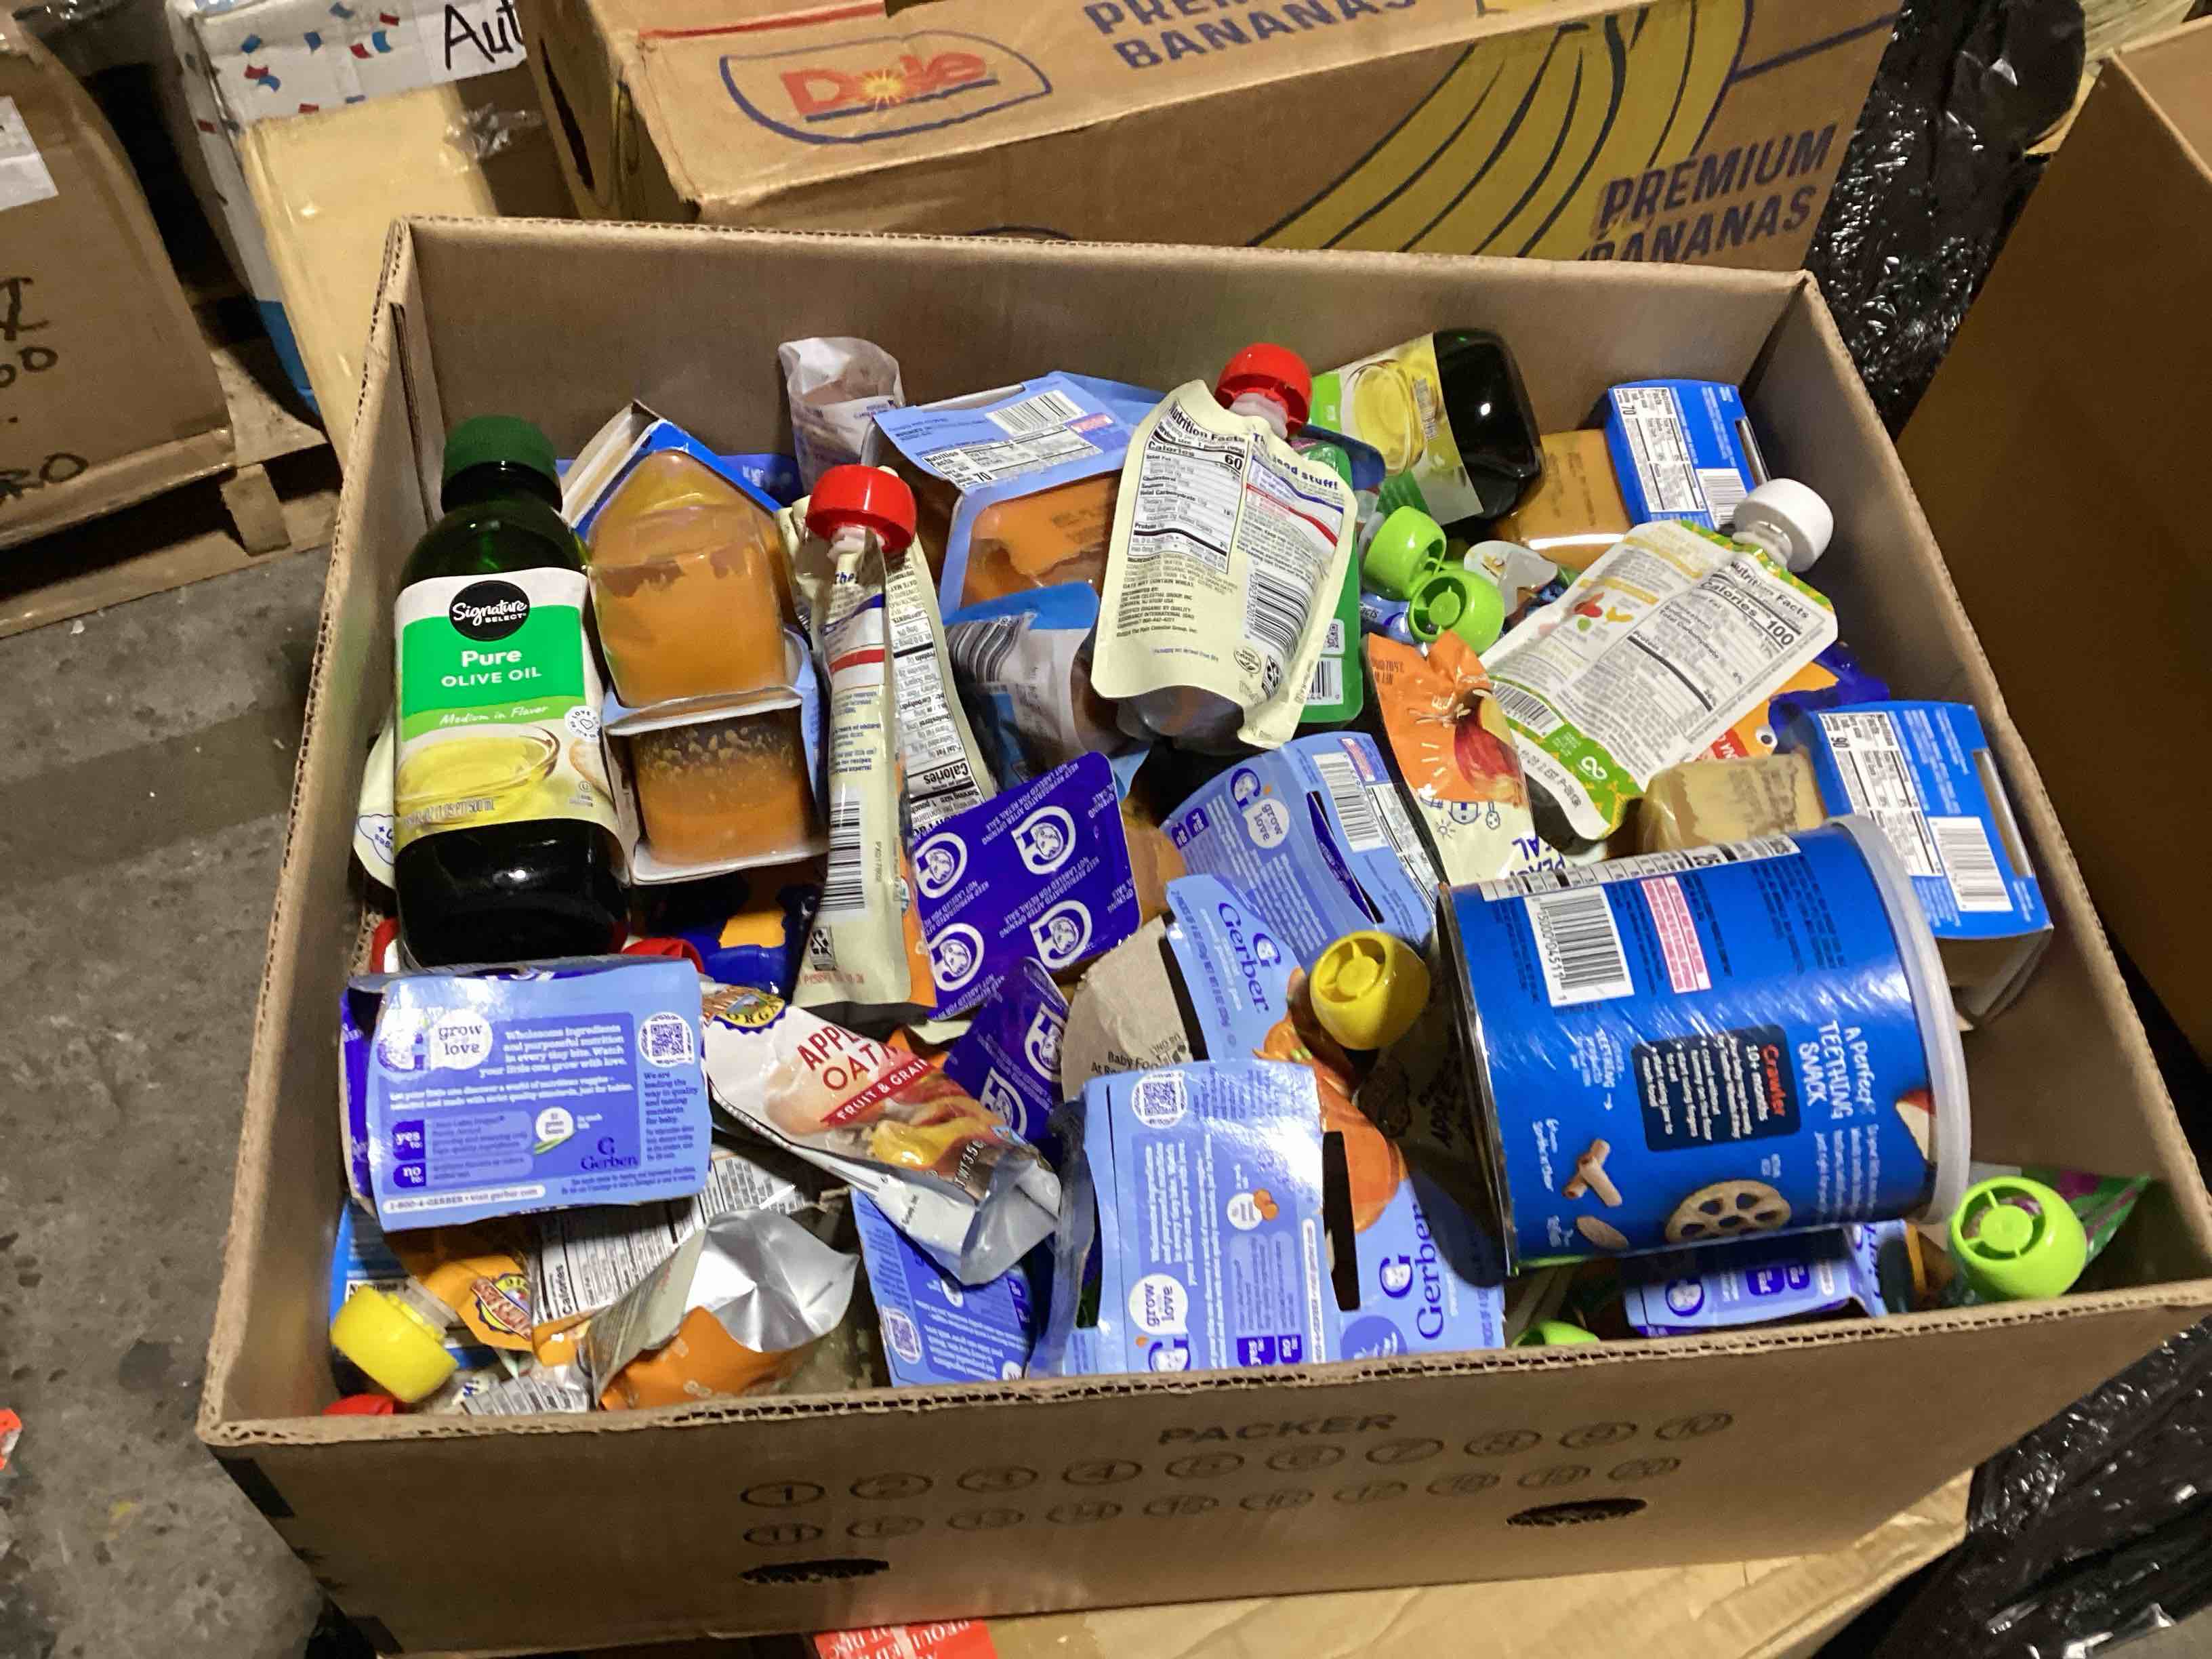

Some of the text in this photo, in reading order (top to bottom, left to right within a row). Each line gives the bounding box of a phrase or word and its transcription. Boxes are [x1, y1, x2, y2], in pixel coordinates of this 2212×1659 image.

[779, 52, 987, 114] Dole
[1599, 123, 1838, 230] PREMIUM
[1622, 405, 1635, 415] 70
[1211, 434, 1245, 443] Facts
[1148, 441, 1243, 470] Calories 60
[1301, 472, 1338, 490] stuff!
[452, 600, 527, 626] Signature
[1701, 581, 1795, 646] Calories 100
[1776, 594, 1809, 618] Facts
[461, 651, 522, 668] Pure
[441, 667, 542, 687] OLIVE OIL
[440, 714, 489, 725] Medium
[512, 706, 548, 718] Flavor
[1830, 733, 1849, 751] 90
[922, 763, 969, 783] Calories
[1005, 806, 1026, 824] AFTER
[1252, 813, 1273, 842] love
[1261, 802, 1284, 837] grow
[979, 821, 1009, 845] OPENING
[1214, 898, 1277, 1015] Gerber
[439, 1025, 483, 1041] grow
[445, 1041, 480, 1055] love
[1595, 1028, 1616, 1088] TEETHING
[1745, 1043, 1769, 1122] 10+ months
[1762, 1044, 1788, 1118] Crawler
[1799, 1043, 1827, 1106] SNACK
[1818, 1020, 1853, 1120] TEETHING
[1843, 1025, 1876, 1113] A Perfect
[835, 1092, 877, 1124] FRUIT
[1676, 1051, 1699, 1138] start using fingers
[1706, 1076, 1721, 1115] without
[396, 1131, 421, 1145] yes
[403, 1166, 422, 1176] no
[1412, 1203, 1444, 1340] Gerber
[1139, 1282, 1164, 1327] grow
[1157, 1284, 1178, 1322] love
[1244, 1338, 1265, 1366] yes
[1279, 1338, 1293, 1357] no
[1158, 1414, 1398, 1446] PACKER
